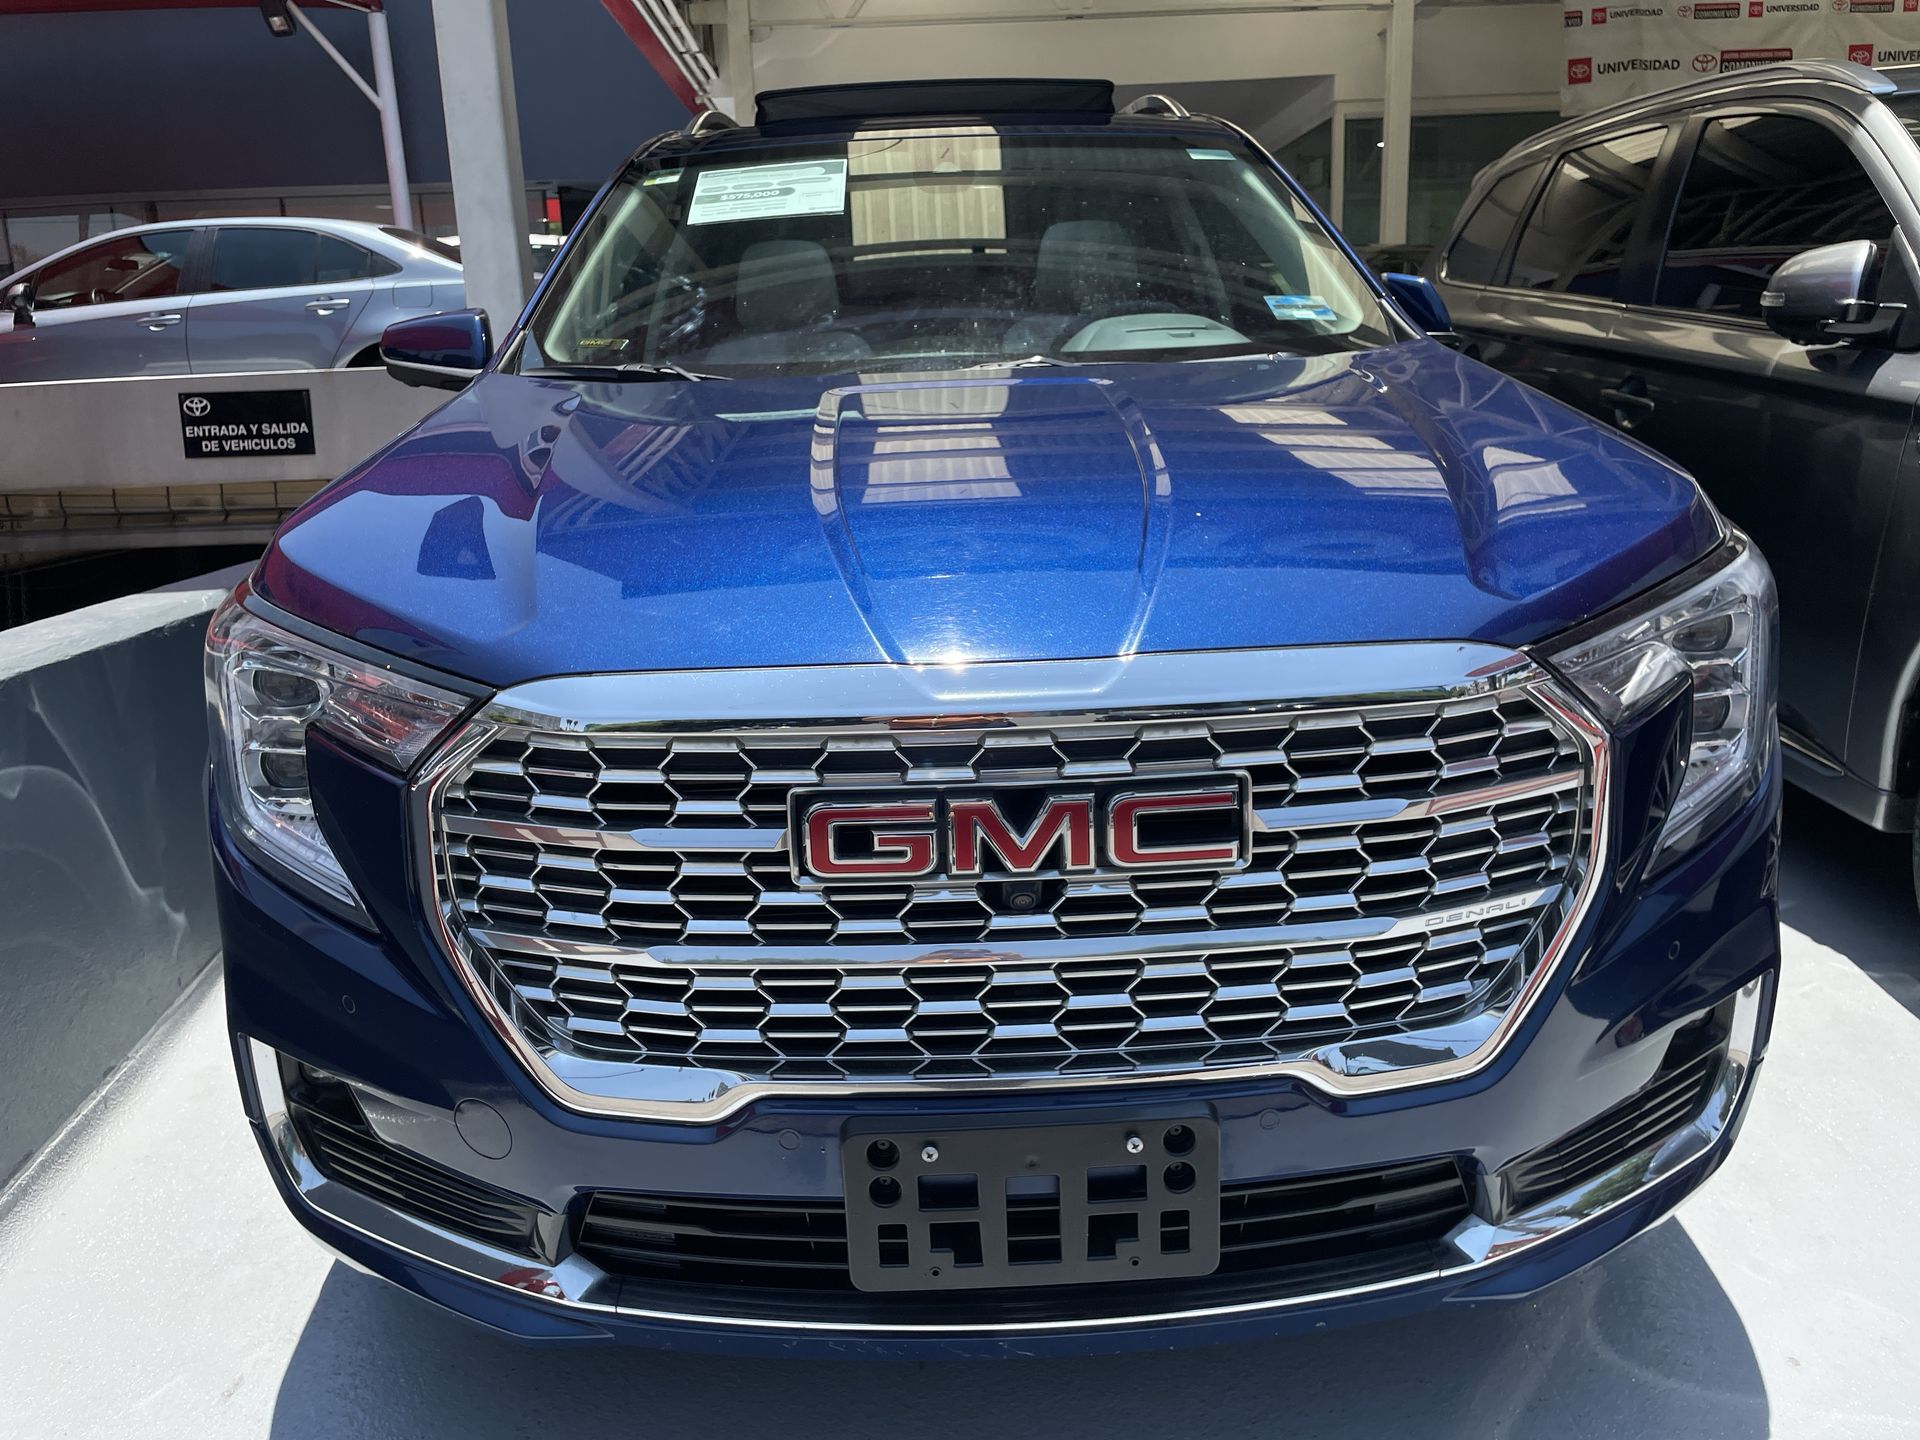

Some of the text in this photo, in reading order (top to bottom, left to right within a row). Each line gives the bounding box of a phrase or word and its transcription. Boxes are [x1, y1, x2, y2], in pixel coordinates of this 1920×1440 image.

[1766, 3, 1820, 13] UNIVERSIDAD
[720, 189, 780, 201] $575,000
[185, 422, 309, 437] ENTRADA Y SALIDA
[202, 437, 296, 452] DE VEHICULOS
[803, 784, 1239, 878] GMC
[1424, 897, 1527, 927] DENALI
